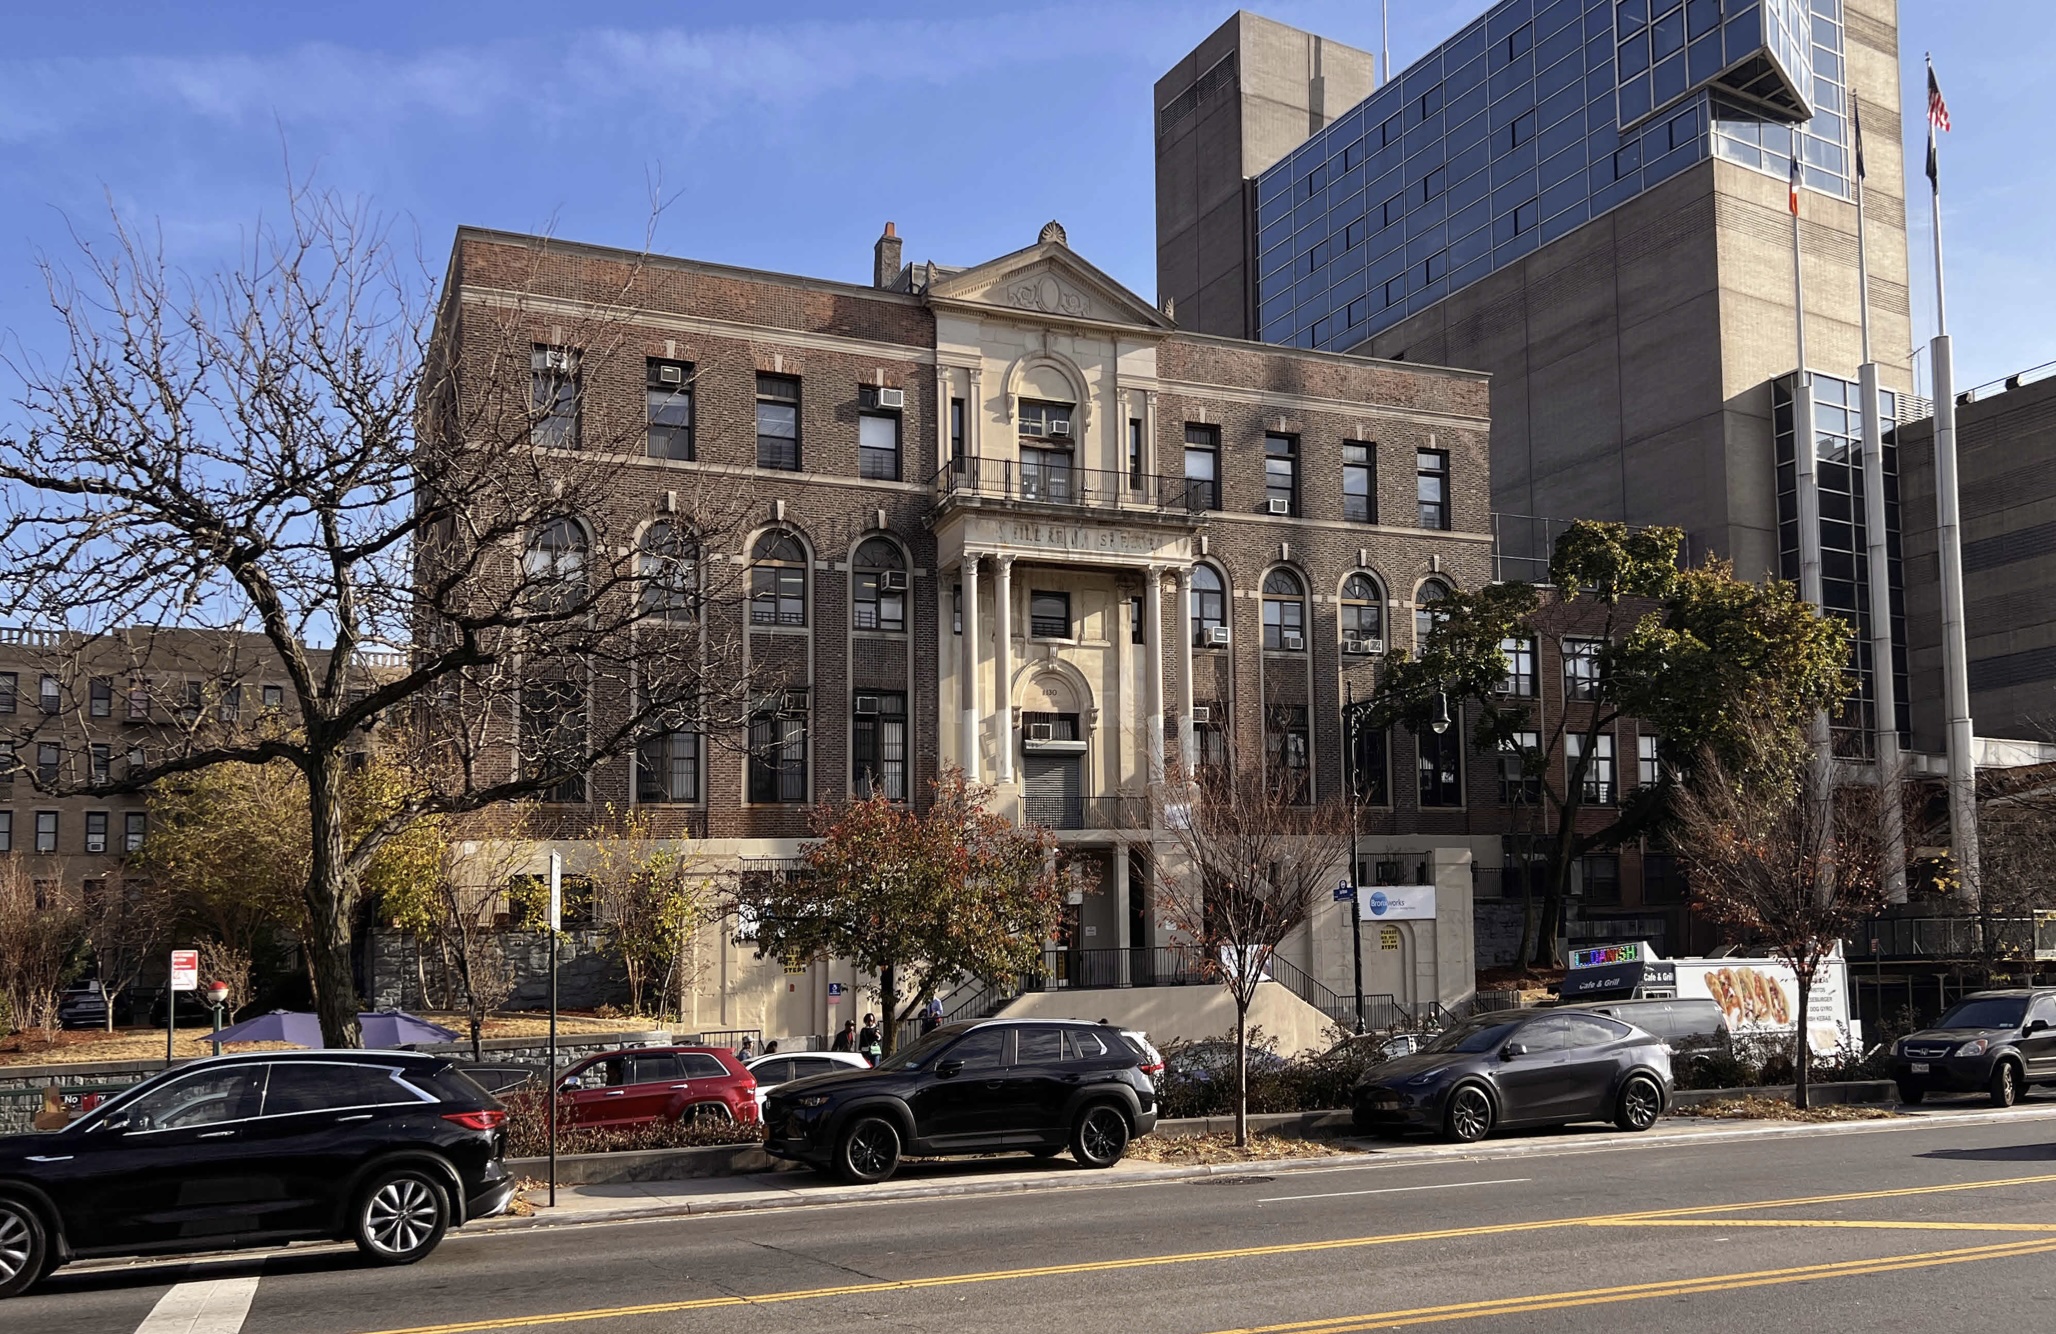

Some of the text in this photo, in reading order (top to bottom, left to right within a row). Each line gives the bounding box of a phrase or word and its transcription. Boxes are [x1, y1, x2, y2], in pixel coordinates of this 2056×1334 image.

[1590, 945, 1635, 964] DANISH
[1643, 972, 1674, 981] Cafe & Grill
[1579, 981, 1595, 989] Cafe
[1604, 978, 1620, 987] Grill
[64, 1095, 79, 1104] No
